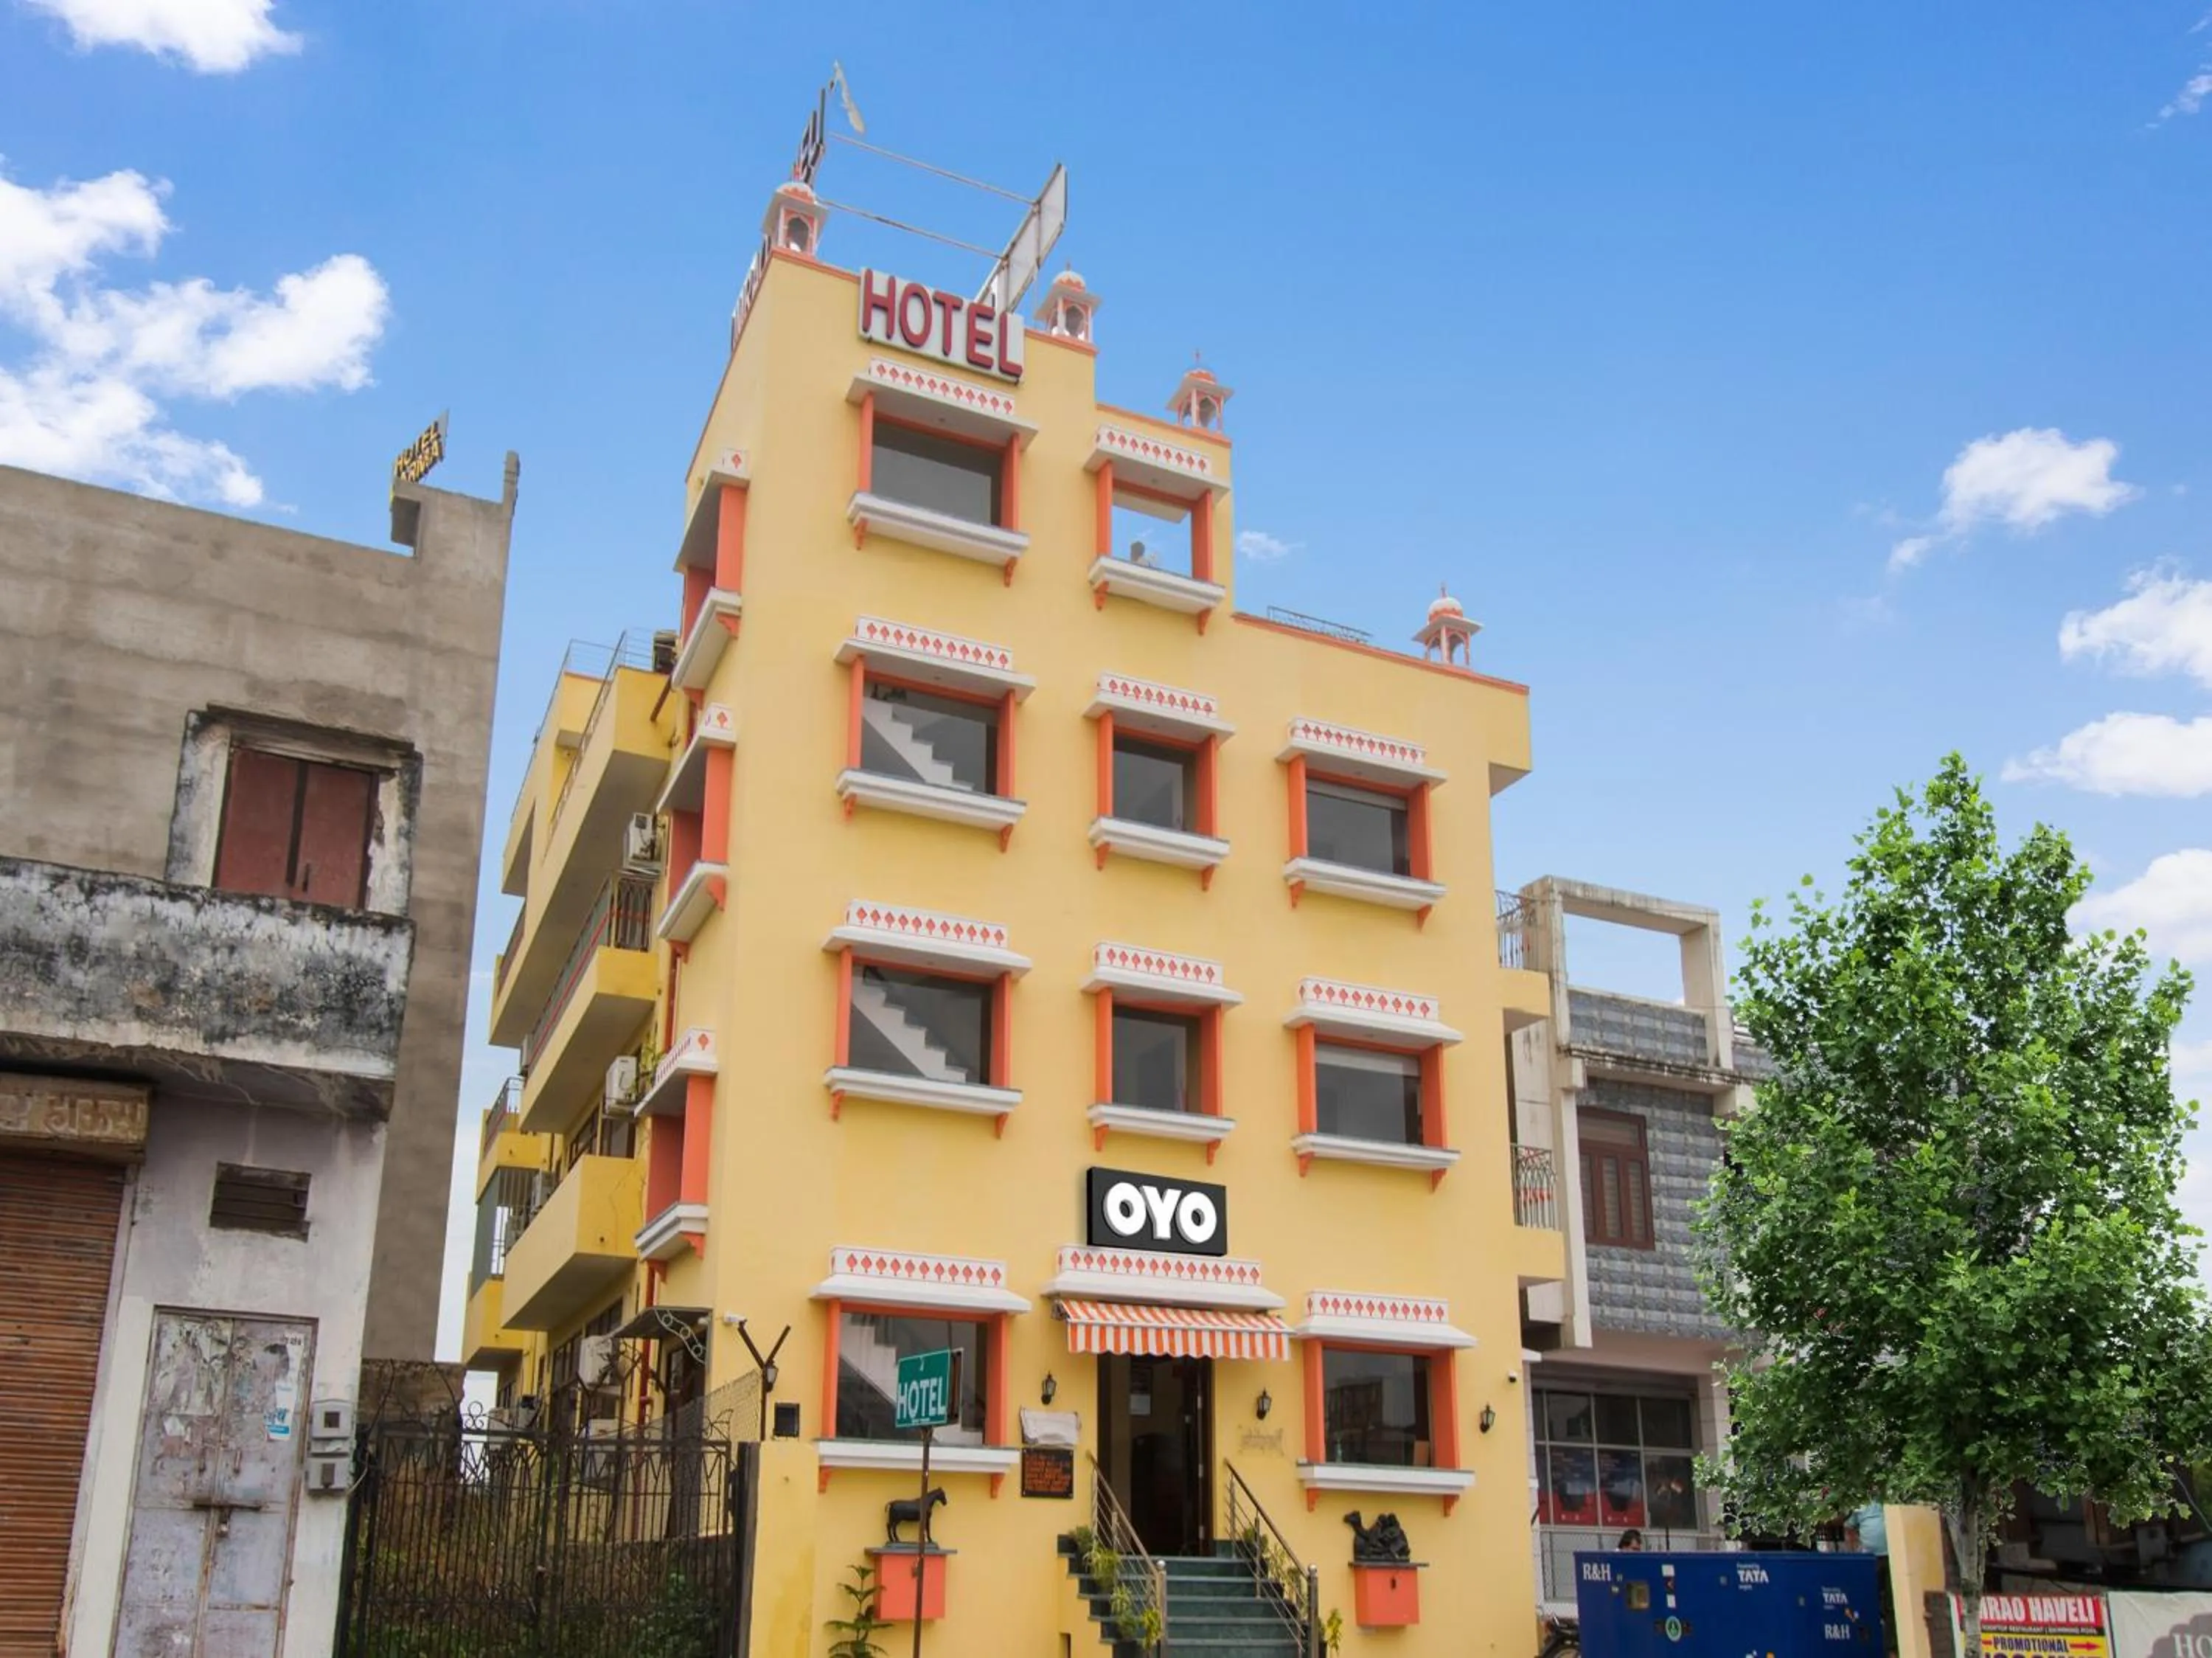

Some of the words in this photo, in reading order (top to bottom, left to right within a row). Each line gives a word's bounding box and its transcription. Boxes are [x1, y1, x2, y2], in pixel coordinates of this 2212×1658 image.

[862, 268, 1023, 379] HOTEL
[1103, 1182, 1217, 1245] OYO
[897, 1376, 947, 1421] HOTEL
[1582, 1561, 1612, 1582] R&H
[1737, 1569, 1770, 1584] TATA
[1822, 1592, 1848, 1604] TATA
[2028, 1596, 2096, 1623] HAVELI
[1824, 1623, 1851, 1640] R&H
[1993, 1636, 2069, 1652] PROMOTIONAL
